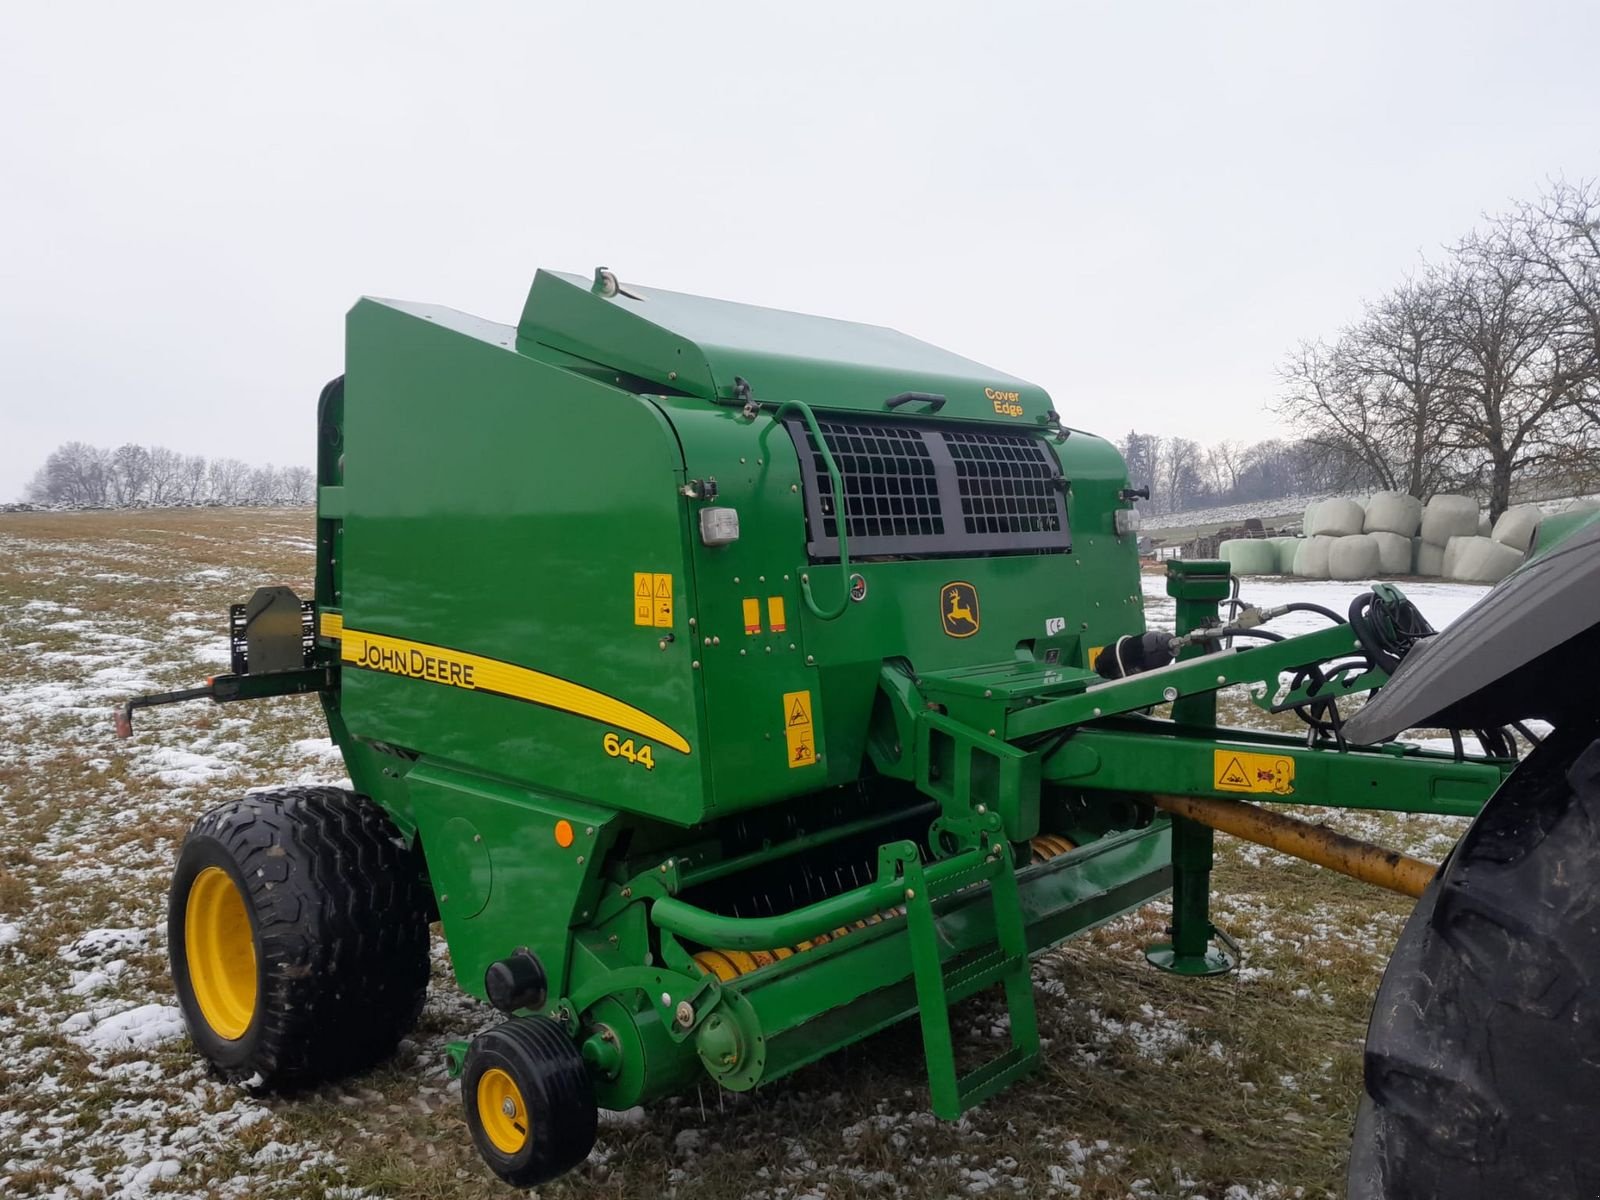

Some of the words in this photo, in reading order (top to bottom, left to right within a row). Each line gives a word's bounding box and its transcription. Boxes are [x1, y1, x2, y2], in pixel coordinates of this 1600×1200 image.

[984, 387, 1019, 402] Cover
[993, 400, 1023, 417] Edge
[358, 640, 407, 673] JOHN
[410, 649, 475, 686] DEERE
[603, 732, 655, 770] 644
